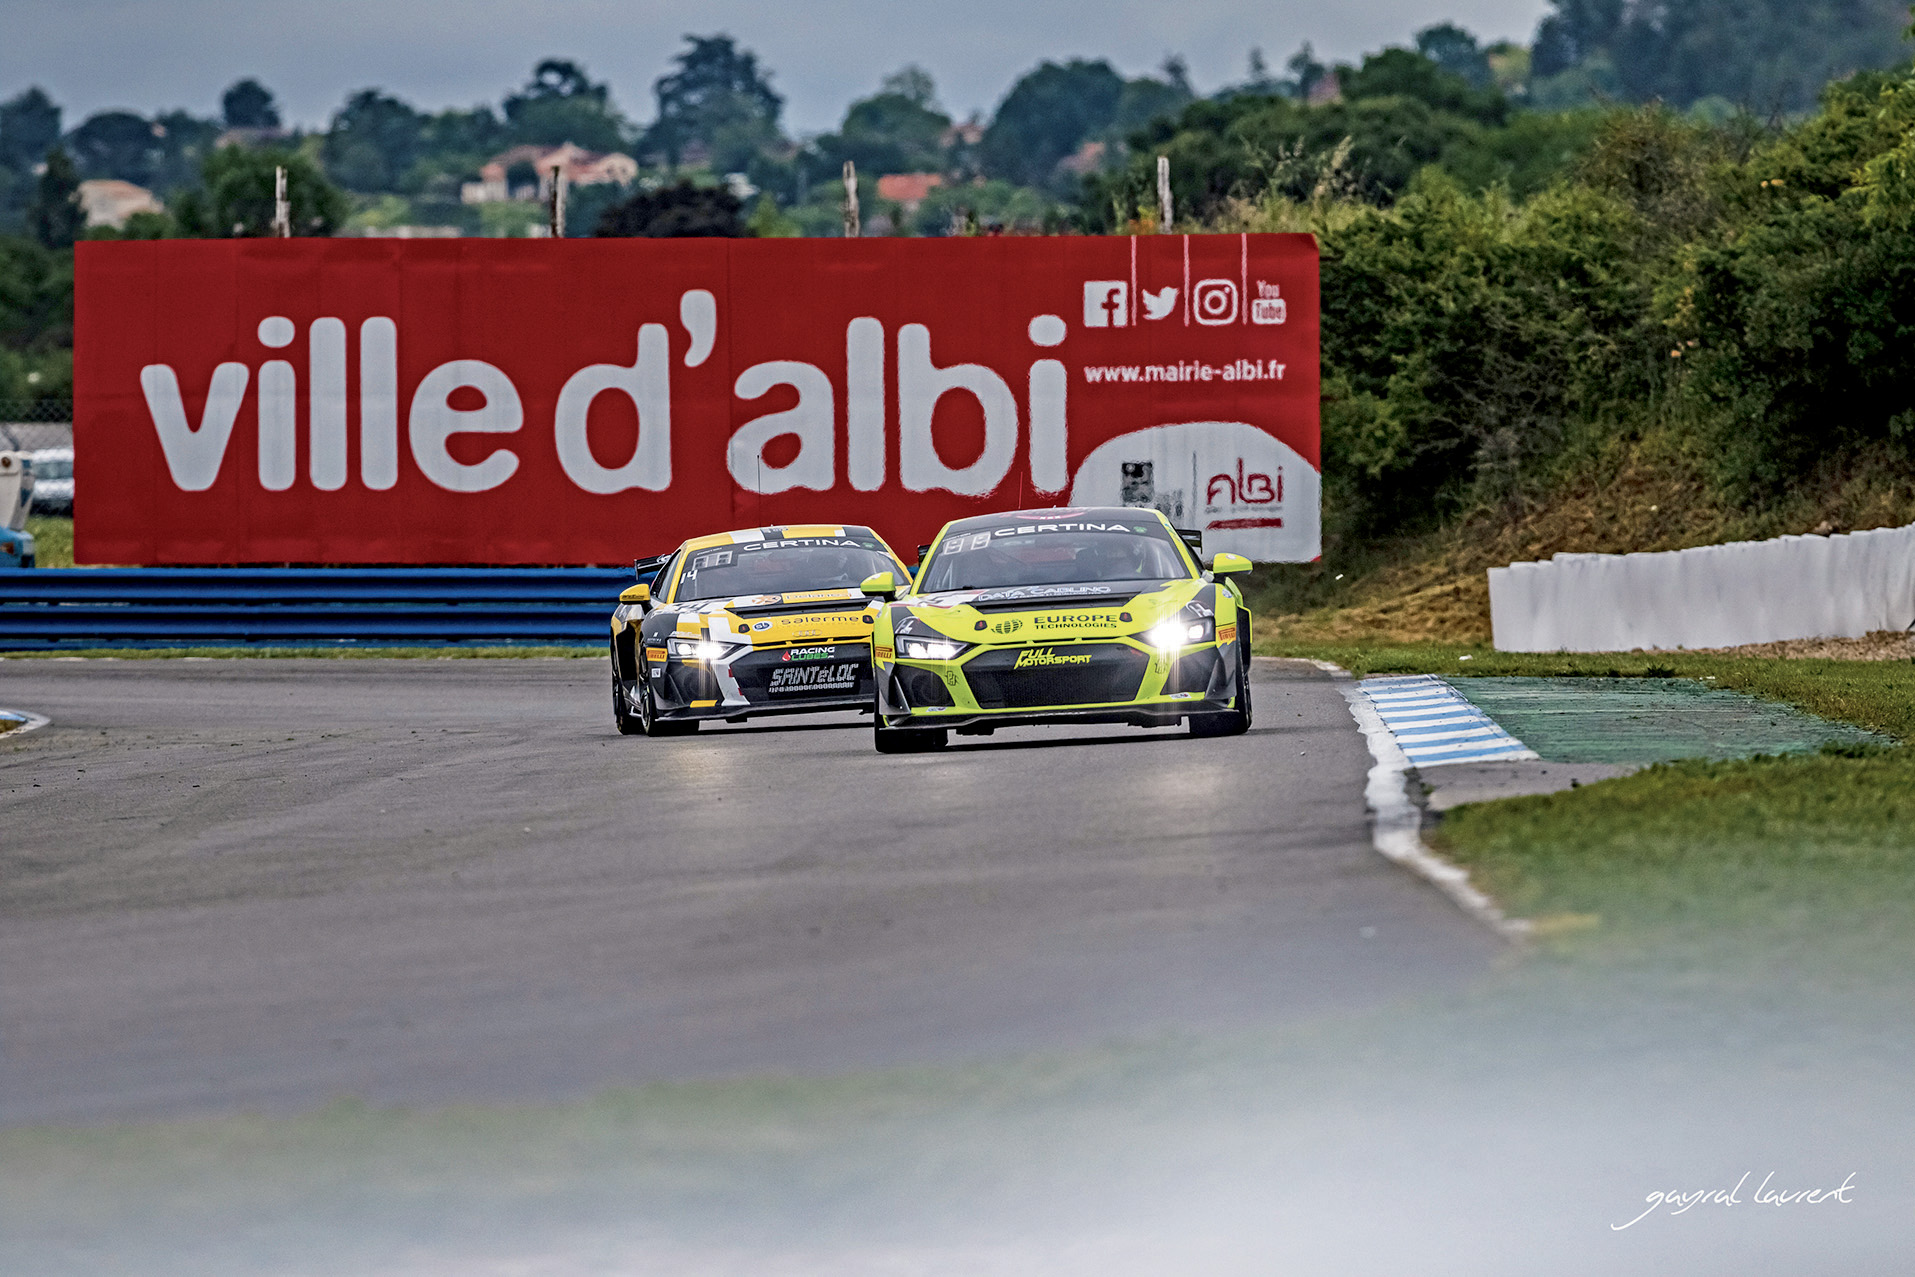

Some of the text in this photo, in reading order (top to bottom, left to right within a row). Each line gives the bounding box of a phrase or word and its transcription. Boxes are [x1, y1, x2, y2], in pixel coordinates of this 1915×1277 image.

[1256, 280, 1280, 297] You
[1255, 302, 1283, 320] Tube
[1084, 360, 1286, 382] www.mairie-albi.fr
[140, 316, 524, 492] ville
[994, 522, 1130, 537] CERTINA
[743, 539, 861, 551] CERTINA
[680, 569, 697, 584] 14
[978, 589, 1025, 602] DATA
[781, 616, 859, 625] salerme
[1034, 615, 1117, 624] EUROPE
[1035, 622, 1117, 630] TECHNOLOGIES
[790, 646, 835, 656] RACING
[1020, 655, 1092, 667] MOTORSPORT
